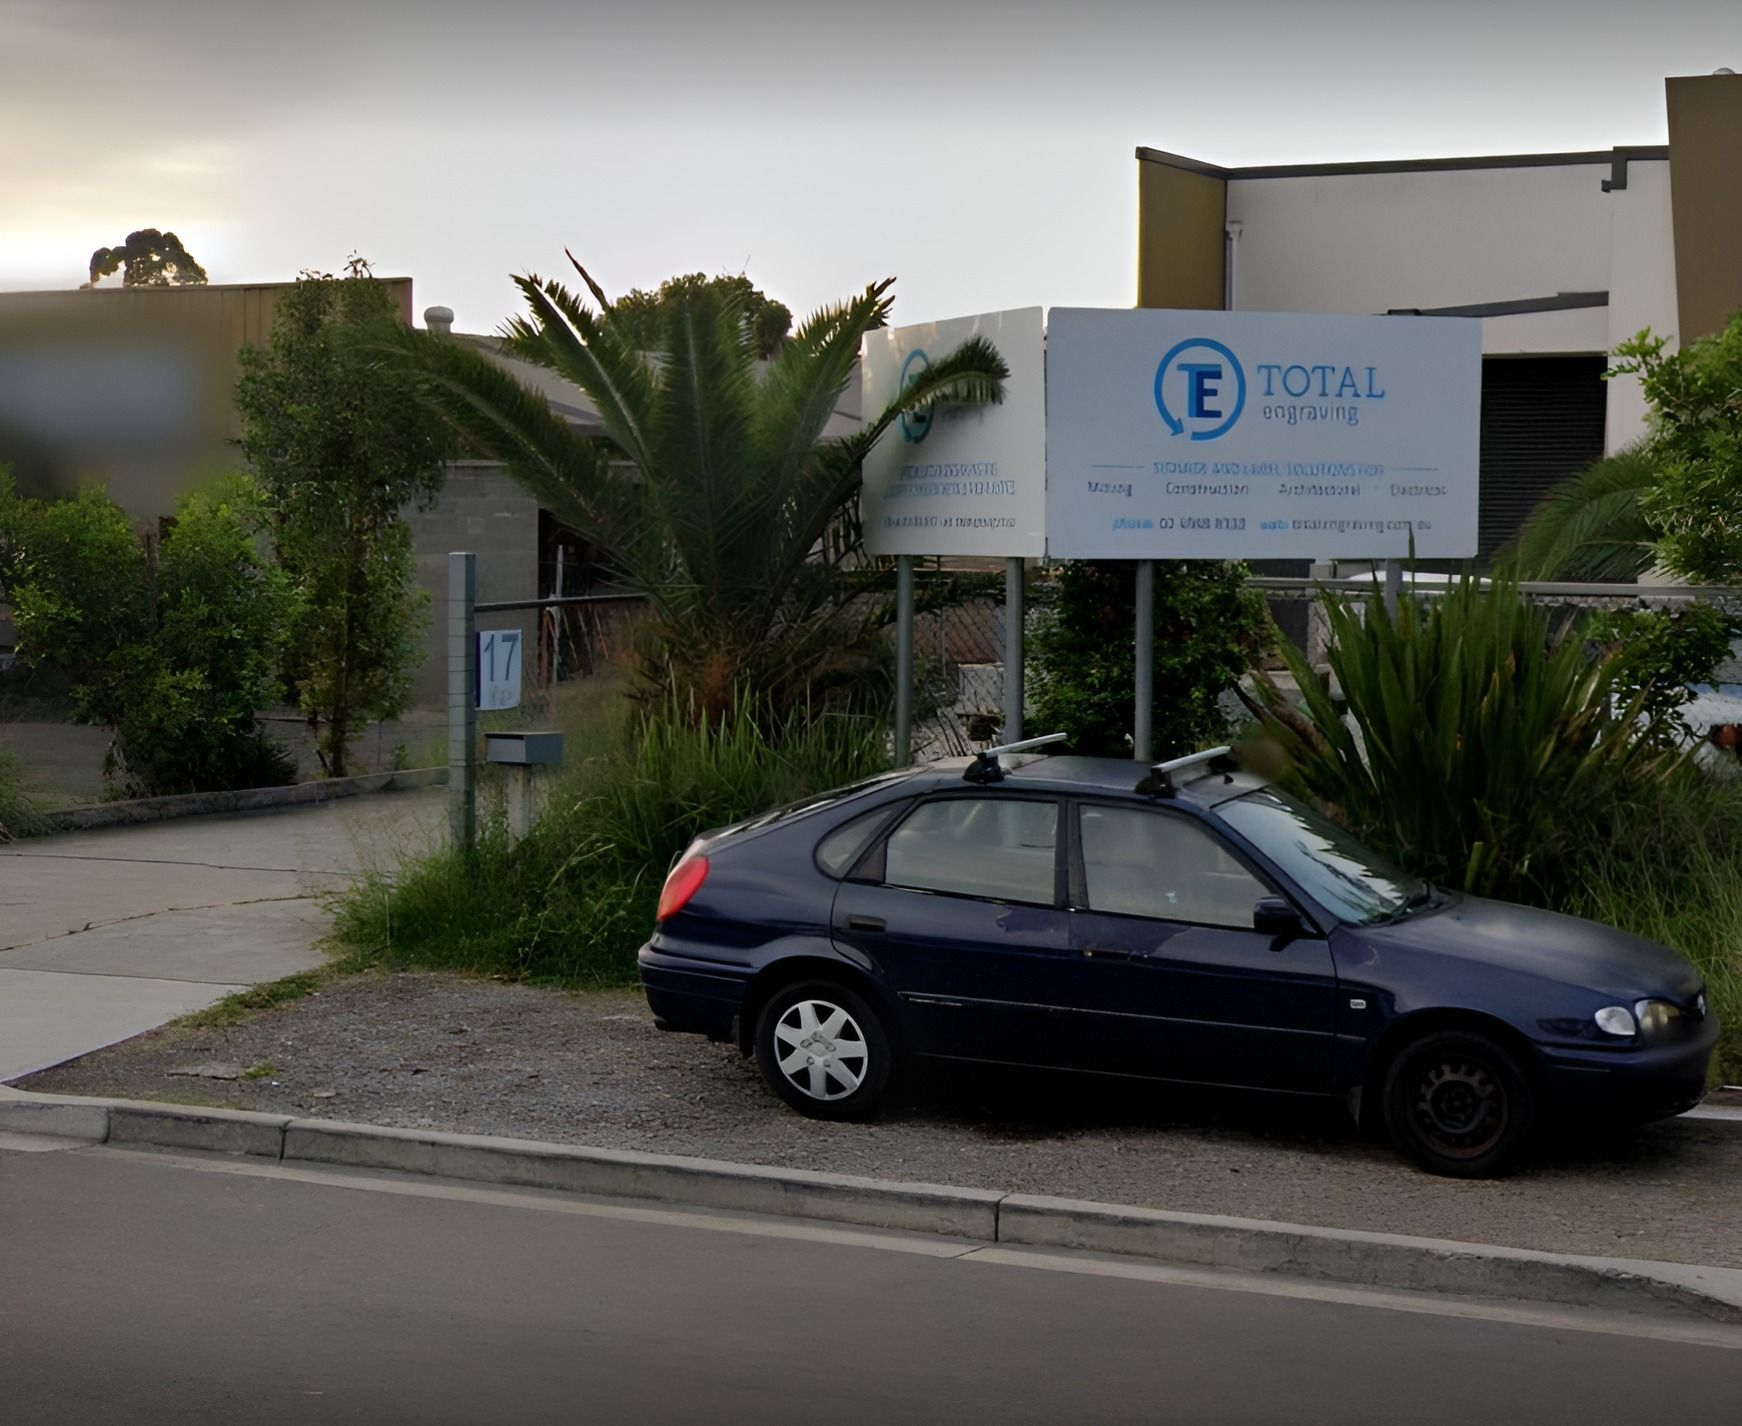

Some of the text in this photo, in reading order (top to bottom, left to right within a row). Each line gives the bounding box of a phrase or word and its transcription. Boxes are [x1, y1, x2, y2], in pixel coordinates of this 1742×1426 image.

[1257, 364, 1385, 399] TOTAL
[1263, 405, 1360, 426] engraving
[484, 633, 519, 682] 17
